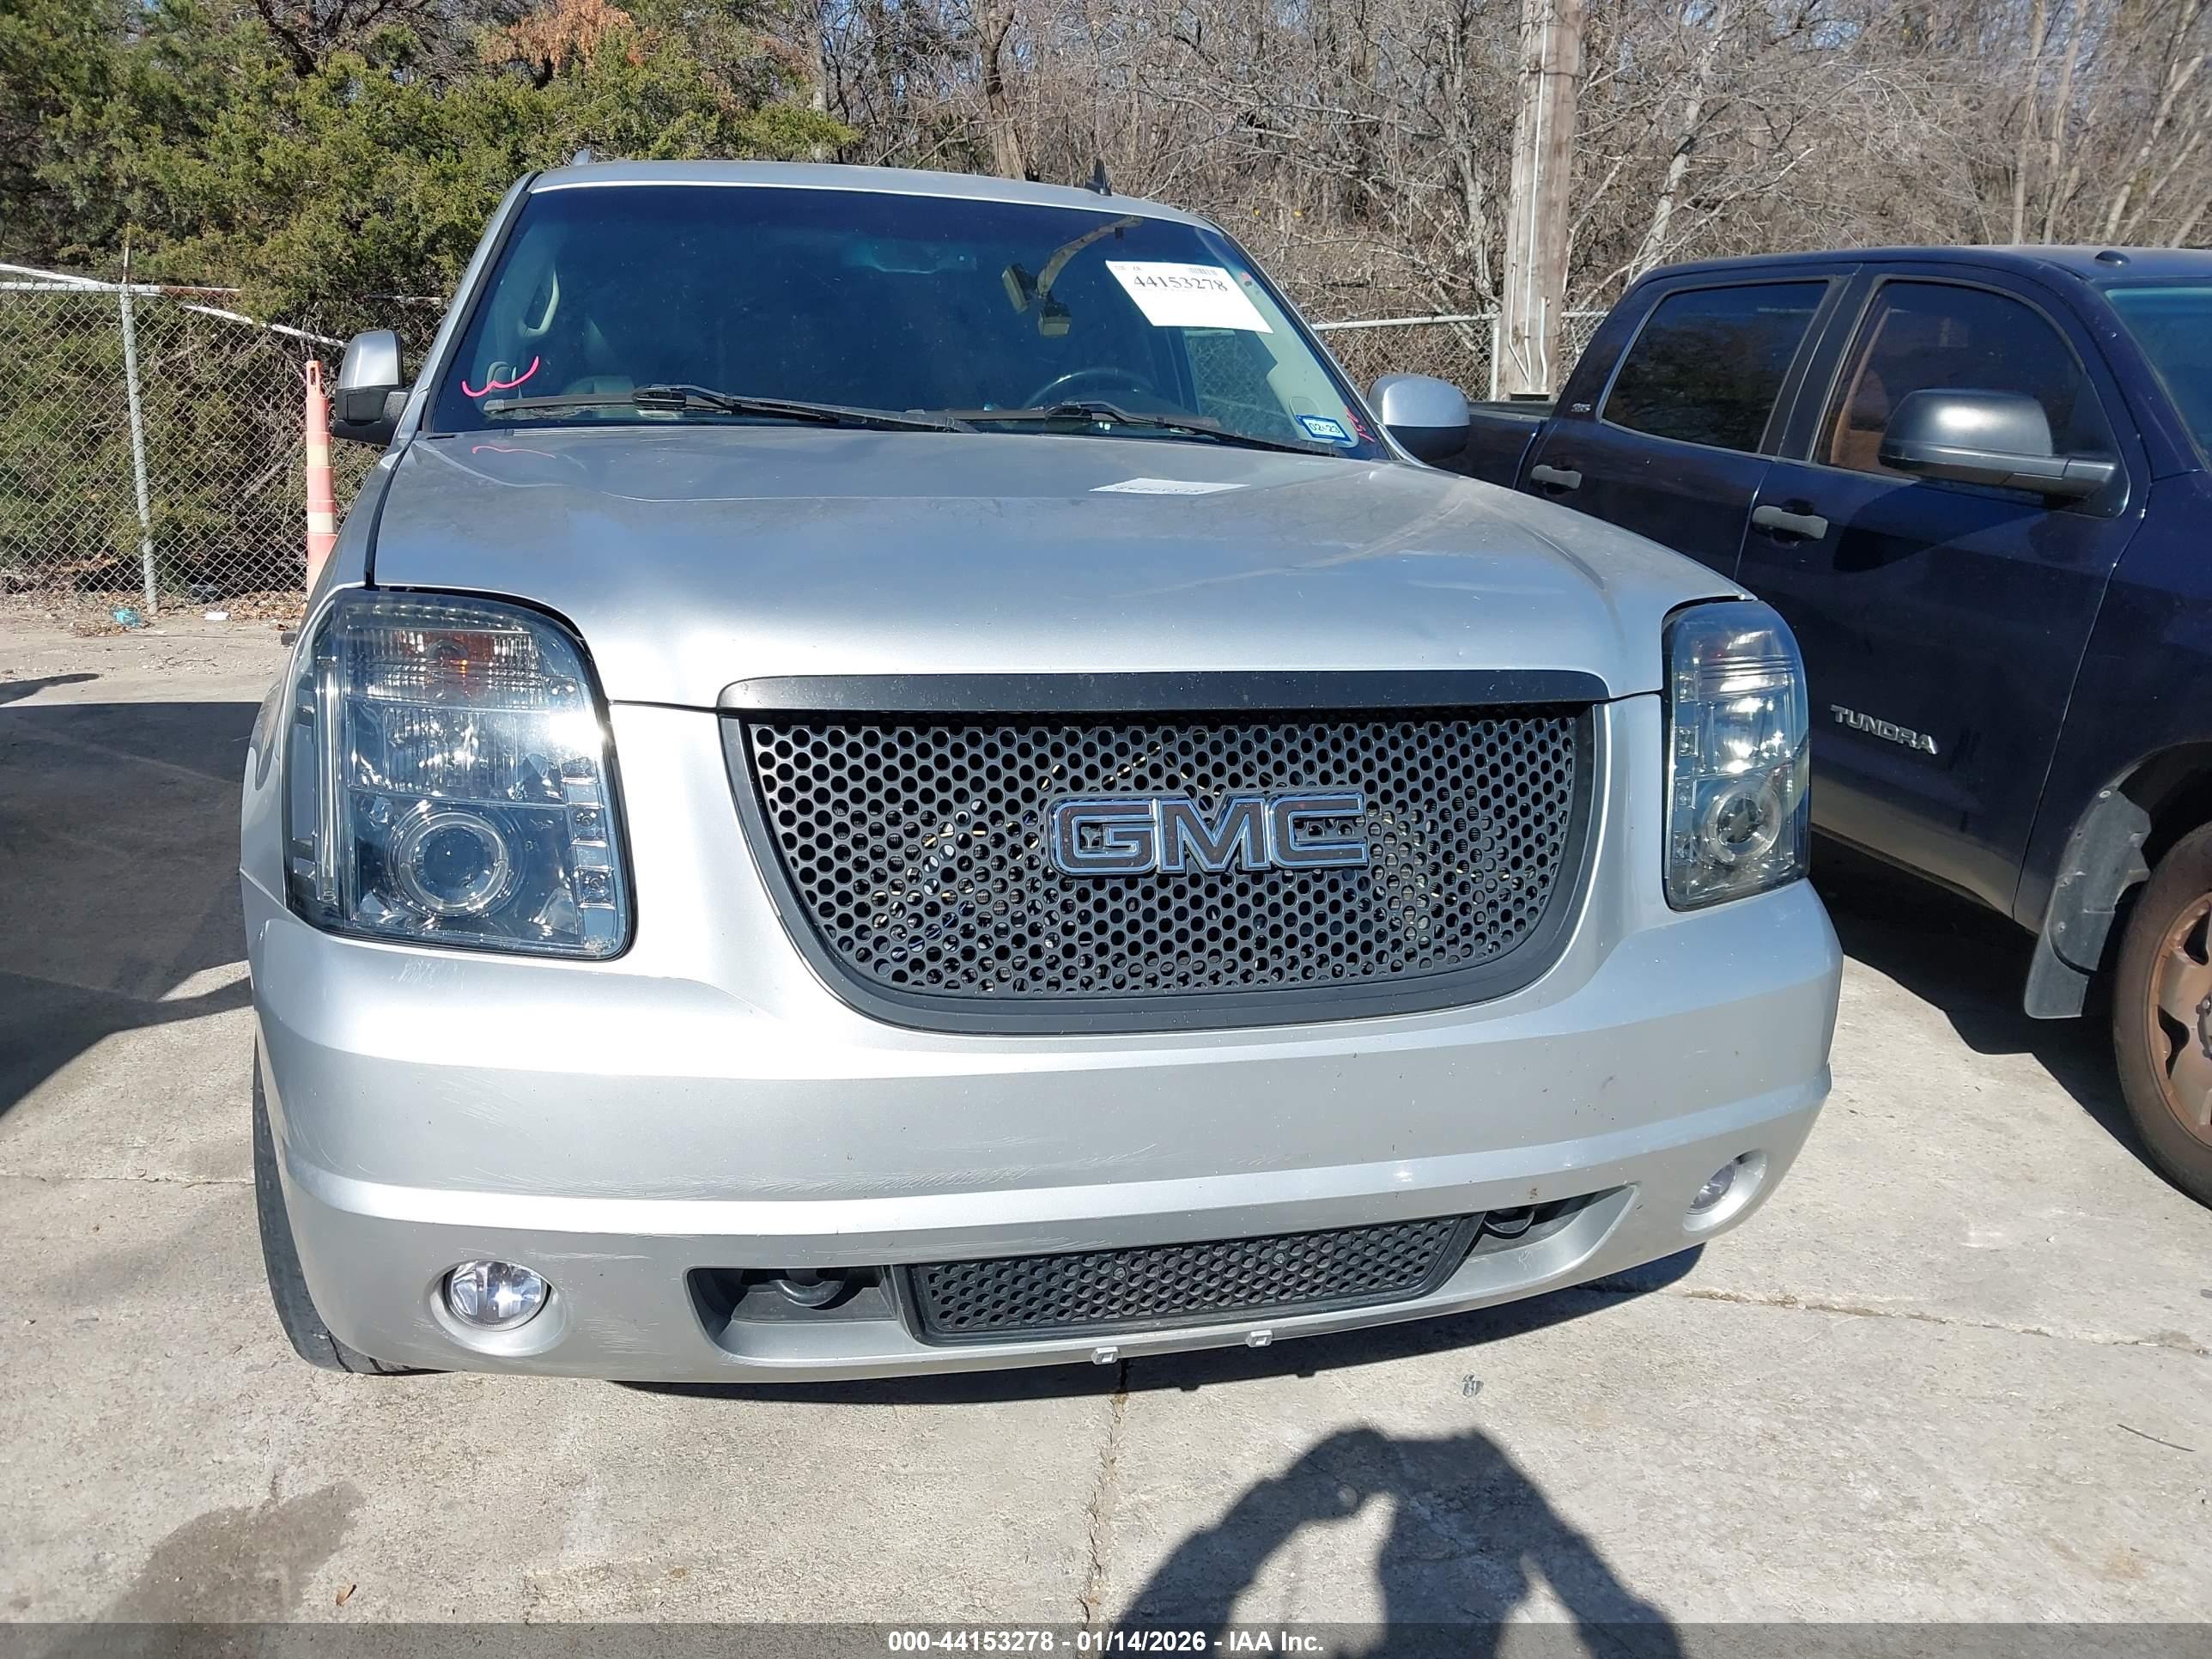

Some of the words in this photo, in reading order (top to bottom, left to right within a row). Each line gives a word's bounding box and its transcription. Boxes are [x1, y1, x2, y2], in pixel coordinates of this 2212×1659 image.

[1133, 276, 1228, 292] 44153278
[1830, 704, 1939, 755] TUNDRA
[1049, 792, 1369, 876] GMC
